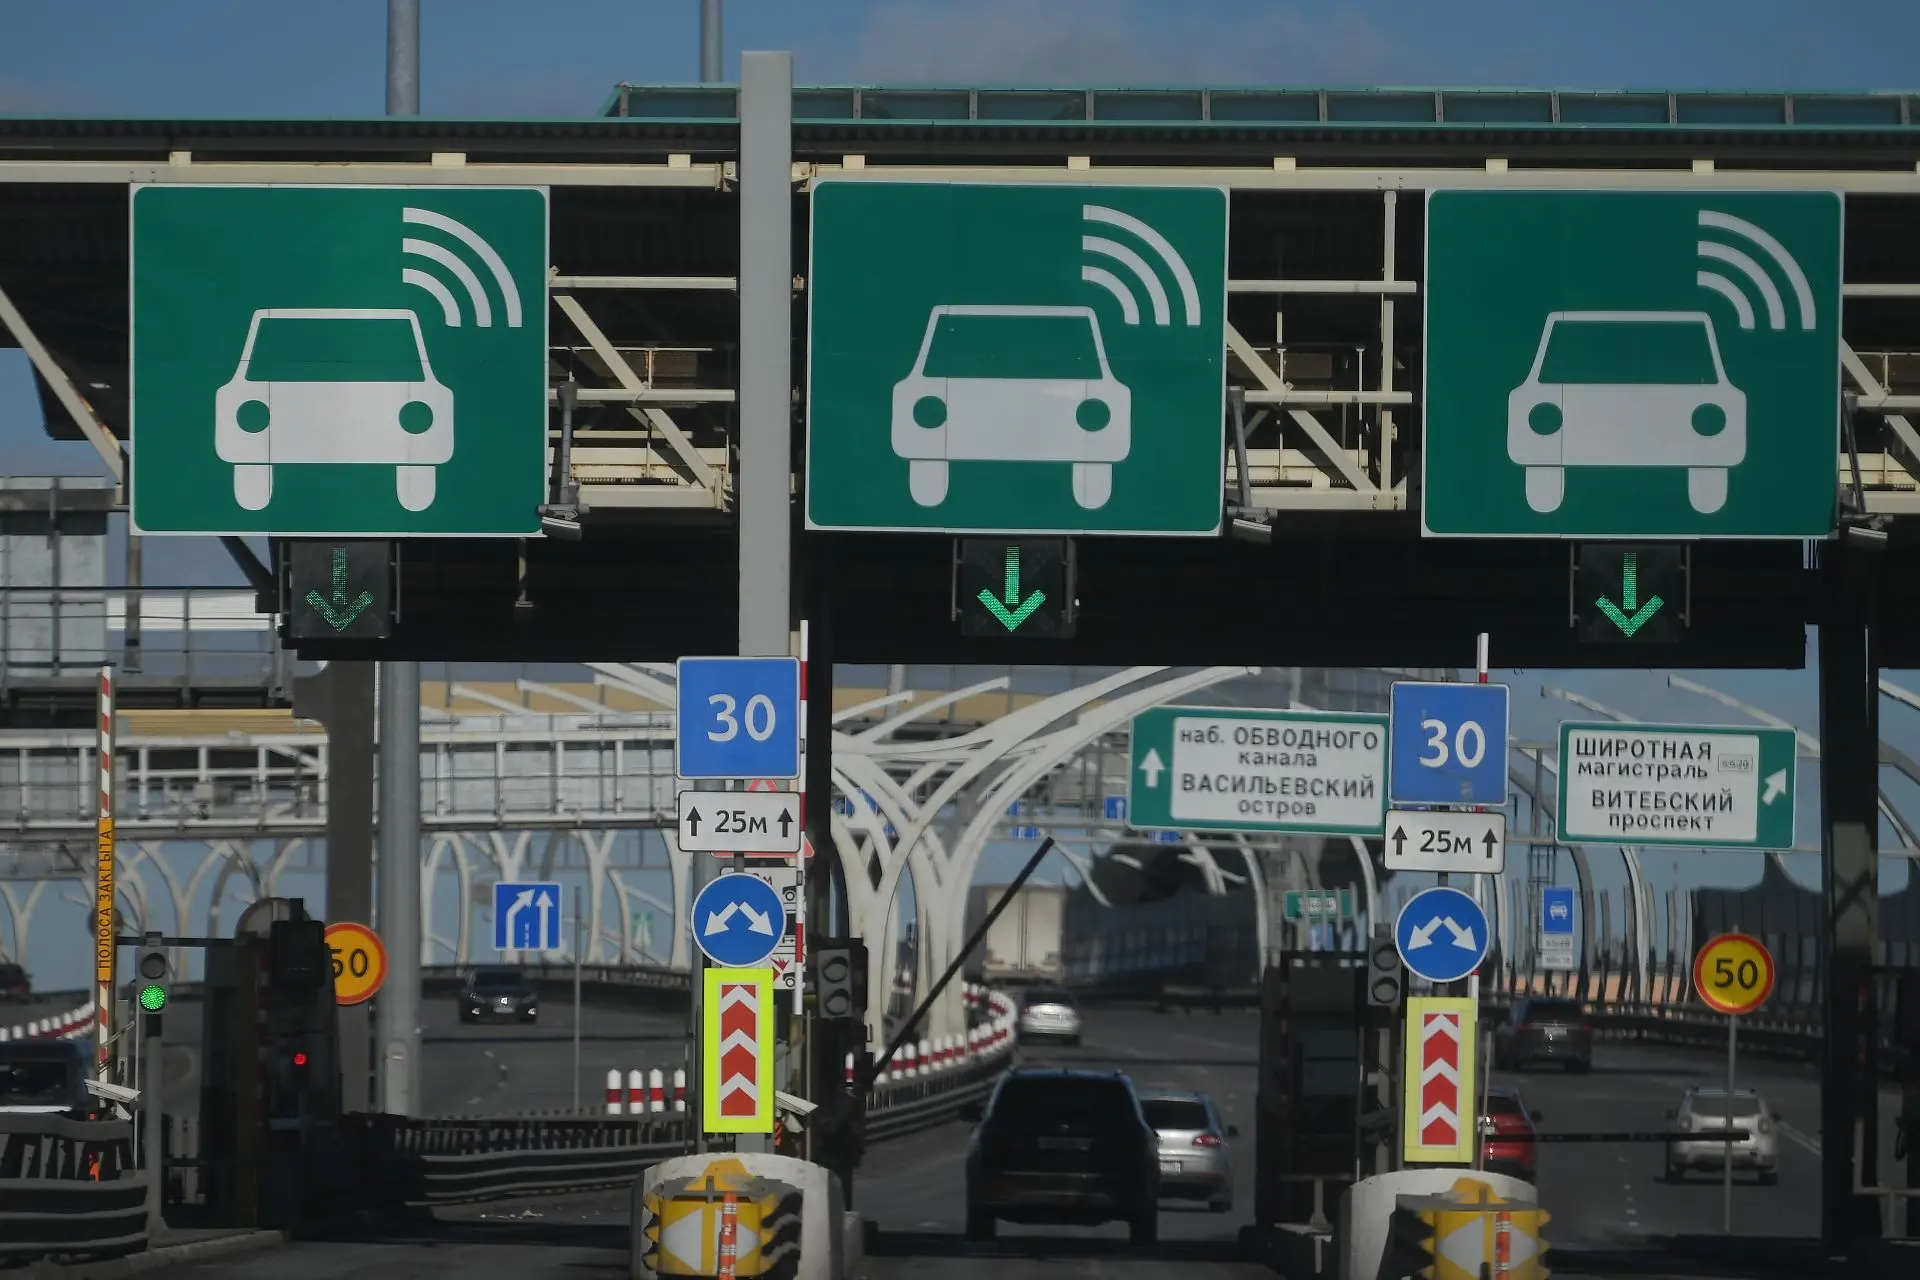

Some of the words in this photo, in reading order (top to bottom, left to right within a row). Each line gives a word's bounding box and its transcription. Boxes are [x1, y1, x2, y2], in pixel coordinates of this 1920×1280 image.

[708, 694, 776, 742] 30
[1180, 725, 1225, 745] наб.
[1234, 726, 1379, 750] ОБВОДНОГО
[1419, 719, 1486, 768] 30
[1576, 737, 1712, 760] ШИРОТНАЯ
[1238, 751, 1318, 768] канала
[1577, 761, 1708, 782] магистраль
[1181, 773, 1374, 798] ВАСИЛЬЕВСКИЙ
[1238, 800, 1317, 819] остров
[1592, 788, 1733, 813] ВИТЕБСКИЙ
[714, 810, 767, 834] 25м
[1609, 813, 1714, 832] проспект
[1419, 830, 1472, 854] 25м
[100, 907, 112, 969] ПОЛОСА
[1714, 957, 1758, 990] 50
